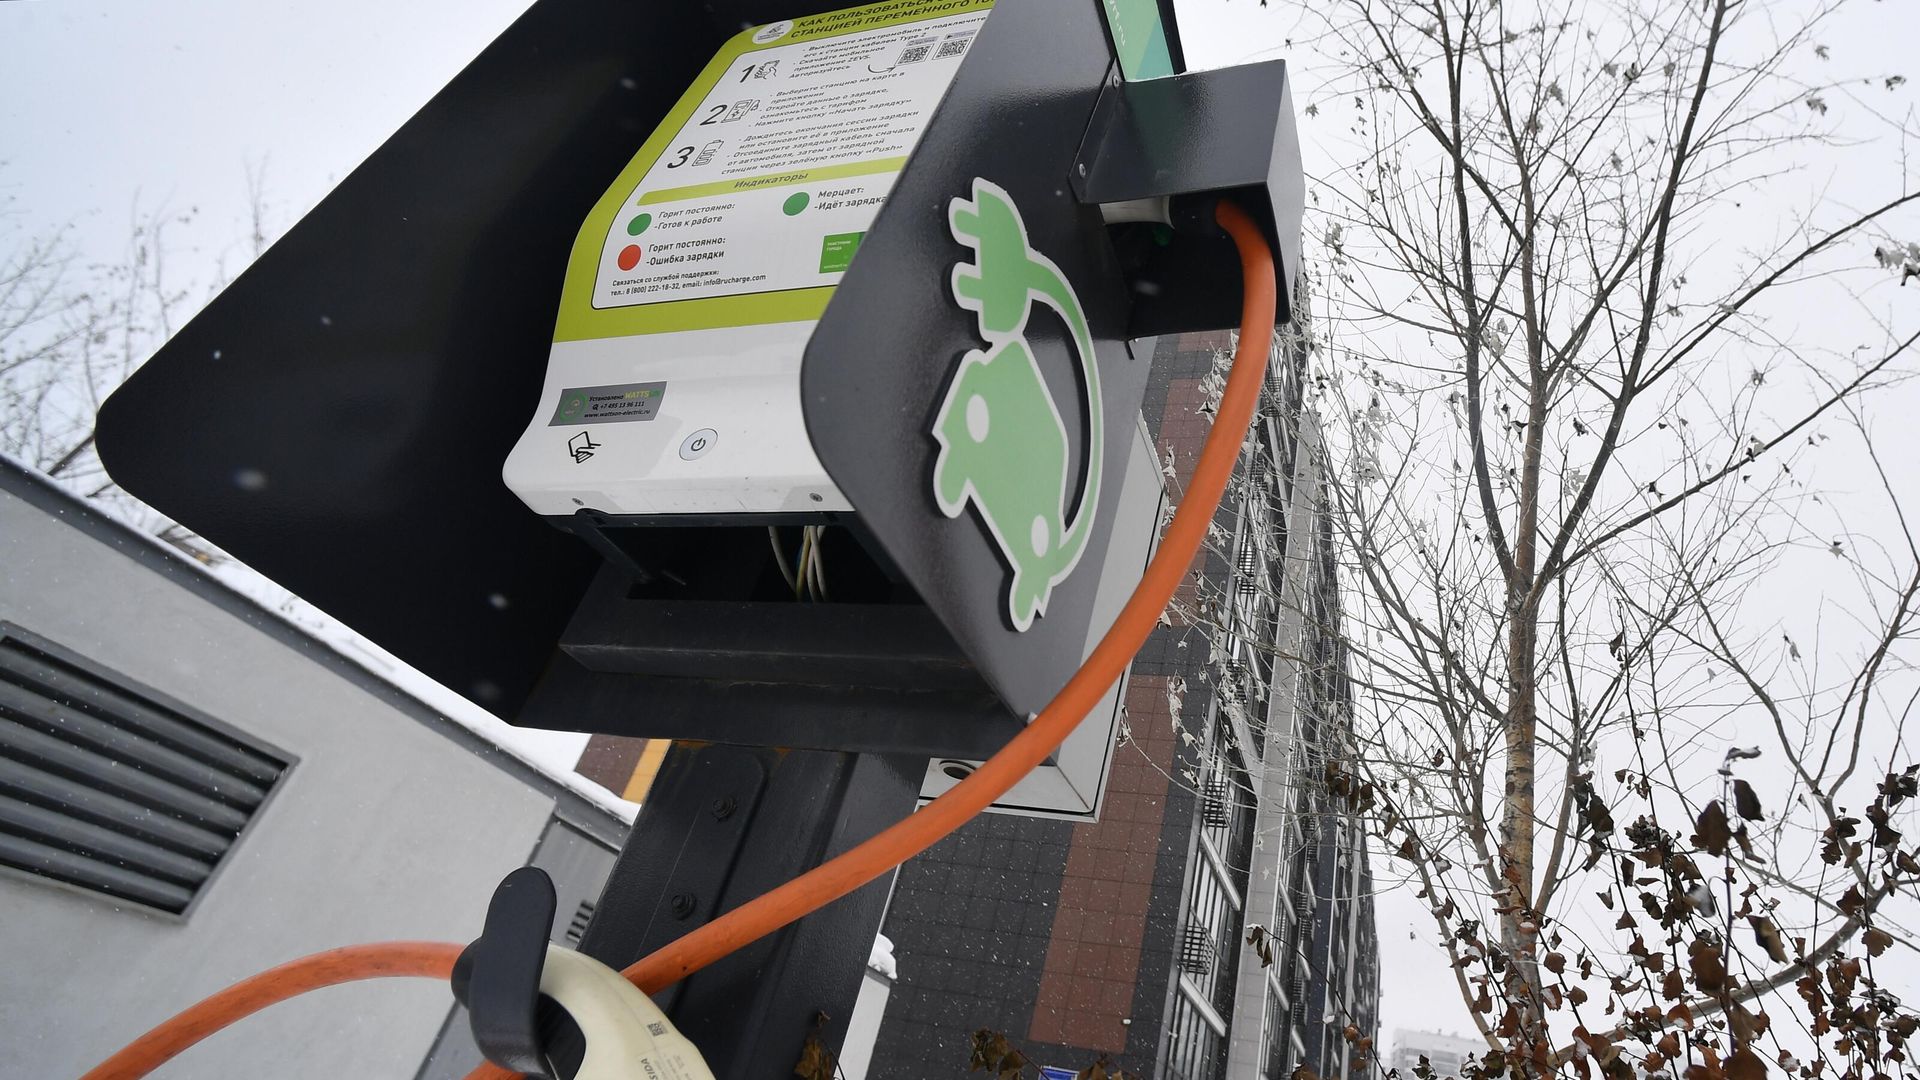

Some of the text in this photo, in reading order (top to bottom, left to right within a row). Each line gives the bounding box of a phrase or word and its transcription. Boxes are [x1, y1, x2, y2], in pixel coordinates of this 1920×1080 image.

[791, 19, 861, 38] СТАНЦИЕЙ
[865, 0, 970, 25] ПЕРЕМЕННОГО
[798, 16, 823, 27] КАК
[808, 40, 855, 51] Выключите
[857, 29, 922, 42] электромобиль
[932, 17, 987, 29] подключите
[825, 45, 859, 54] станции
[861, 38, 898, 47] кабелем
[900, 34, 919, 42] Type
[799, 46, 885, 65] Скачайте мобильное
[740, 64, 756, 83] 1
[789, 65, 850, 78] Авторизуйтесь
[794, 59, 846, 72] приложение
[776, 86, 818, 97] Выберите
[820, 79, 857, 90] станцию
[872, 73, 898, 82] карте
[766, 100, 805, 112] Откройте
[806, 96, 841, 106] данные
[771, 91, 825, 104] приложении
[700, 104, 728, 126] 2
[755, 117, 794, 127] Нажмите
[795, 112, 826, 121] кнопку
[829, 105, 866, 115] «Начать
[760, 106, 819, 120] ознакомьтесь
[828, 99, 867, 109] тарифом
[744, 111, 919, 142] Дождитесь окончания сессии зарядки
[758, 135, 808, 147] остановите
[830, 122, 890, 136] приложение
[734, 127, 915, 158] Отсоедините зарядный кабель сначала
[797, 148, 824, 156] затем
[839, 139, 885, 150] зарядной
[667, 146, 695, 169] 3
[721, 165, 758, 175] станции
[760, 161, 787, 169] через
[788, 155, 828, 166] зелёную
[830, 150, 863, 160] кнопку
[734, 173, 808, 189] Индикаторы
[818, 187, 865, 198] Мерцает:
[658, 203, 736, 220] Горит постоянно:
[814, 196, 888, 210] -Идёт зарядка
[654, 222, 682, 230] -Готов
[690, 215, 723, 227] работе
[648, 237, 726, 253] Горит постоянно:
[646, 250, 725, 266] -Ошибка зарядки
[612, 278, 644, 287] Связаться
[653, 272, 680, 283] службой
[681, 270, 720, 279] поддержки:
[631, 286, 647, 296] (800)
[682, 281, 702, 289] email:
[703, 274, 767, 286] info@rucharge.com
